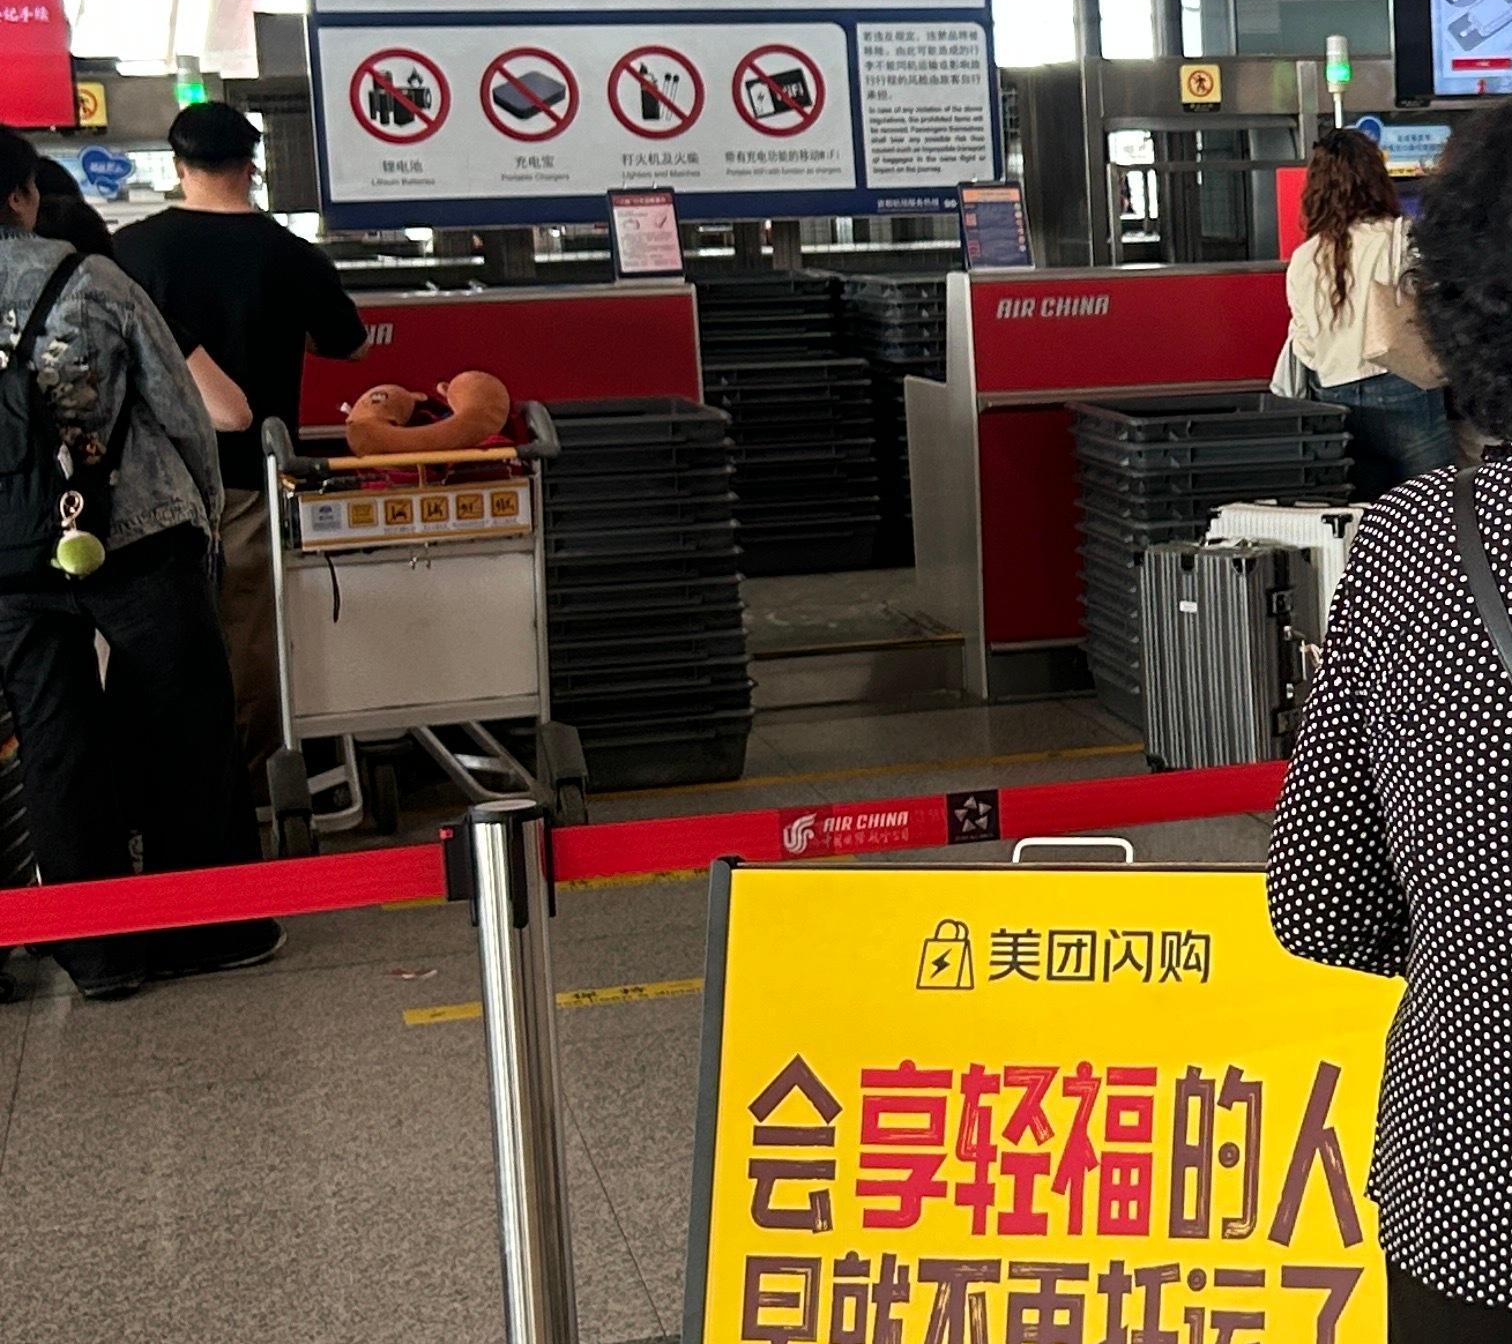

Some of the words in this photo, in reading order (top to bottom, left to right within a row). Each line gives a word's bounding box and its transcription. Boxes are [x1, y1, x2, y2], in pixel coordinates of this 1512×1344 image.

[997, 297, 1036, 320] AIR
[1040, 294, 1110, 318] CHINA
[823, 816, 853, 833] AIR
[856, 811, 910, 829] CHINA
[988, 927, 1211, 985] 美团闪购
[746, 1052, 1366, 1249] 会享轻福的人
